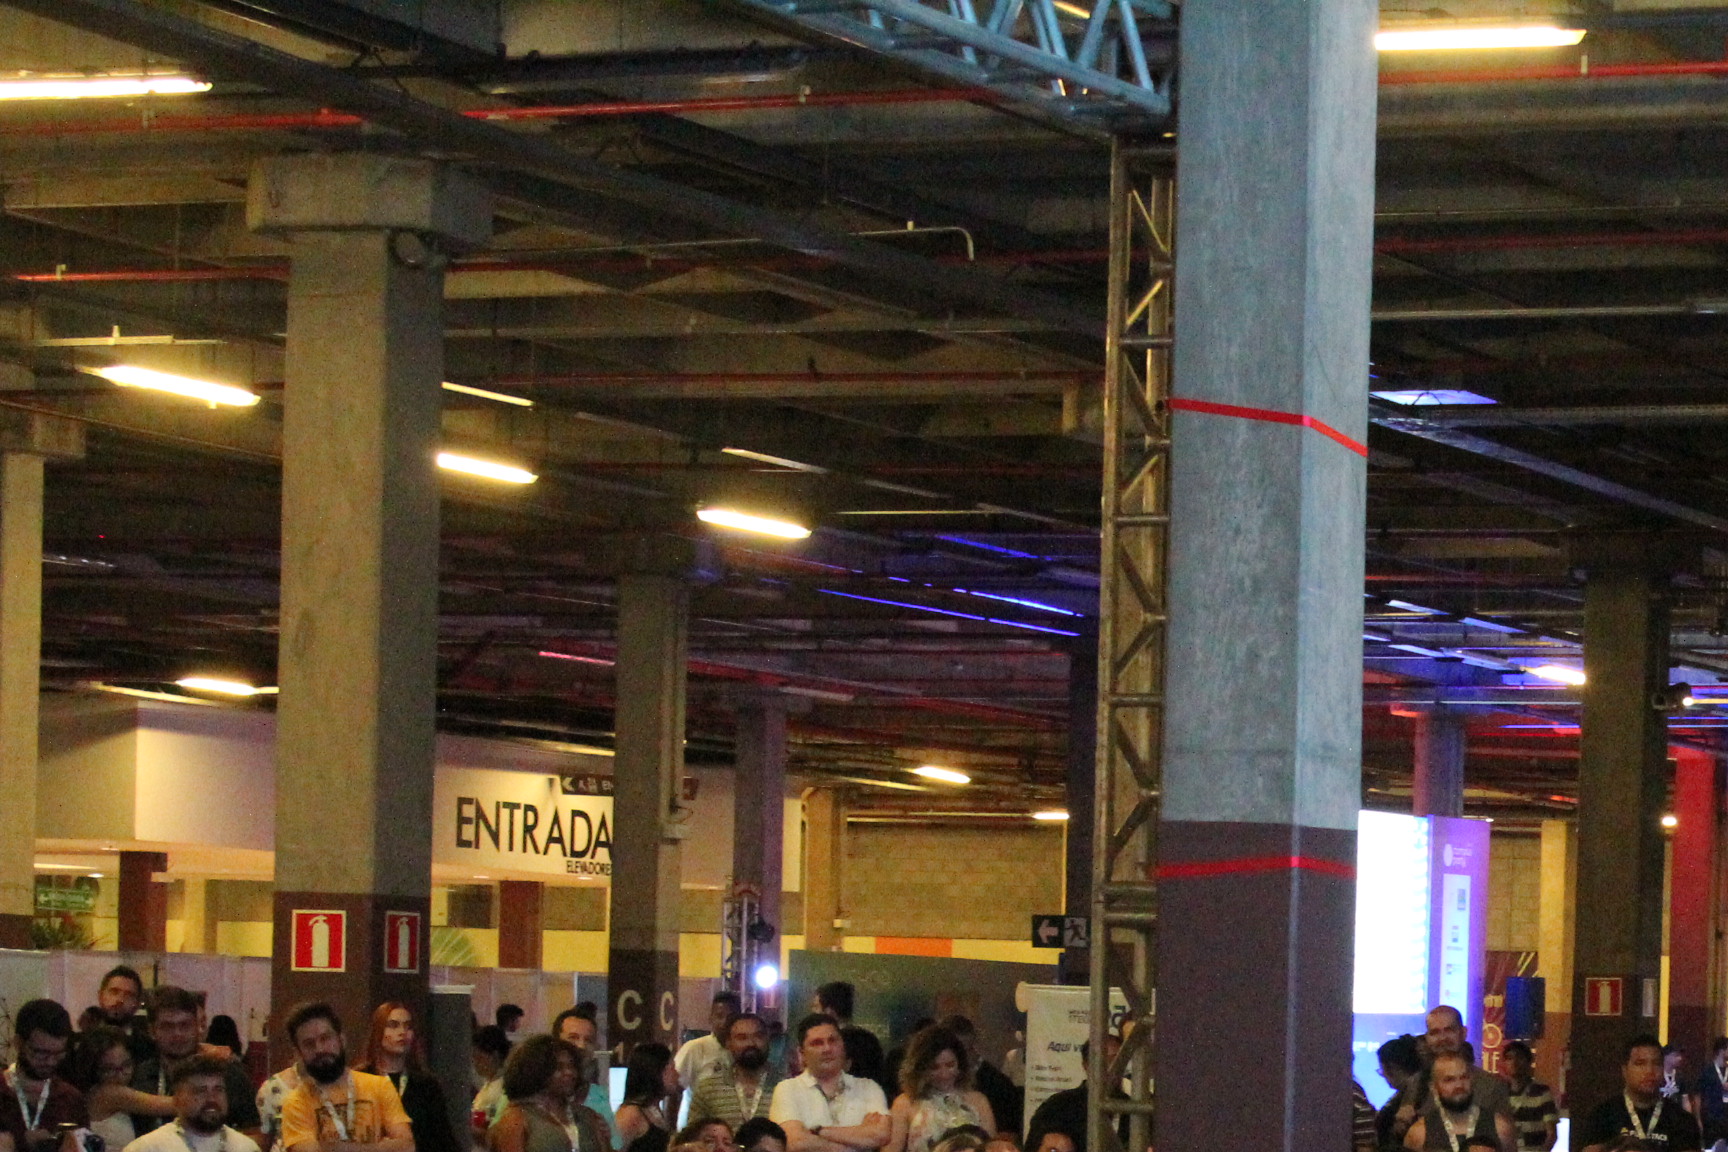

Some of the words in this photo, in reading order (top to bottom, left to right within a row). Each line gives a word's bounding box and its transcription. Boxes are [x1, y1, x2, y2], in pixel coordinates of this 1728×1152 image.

[456, 796, 613, 860] ENTRADA
[617, 989, 642, 1030] C
[660, 991, 674, 1031] C
